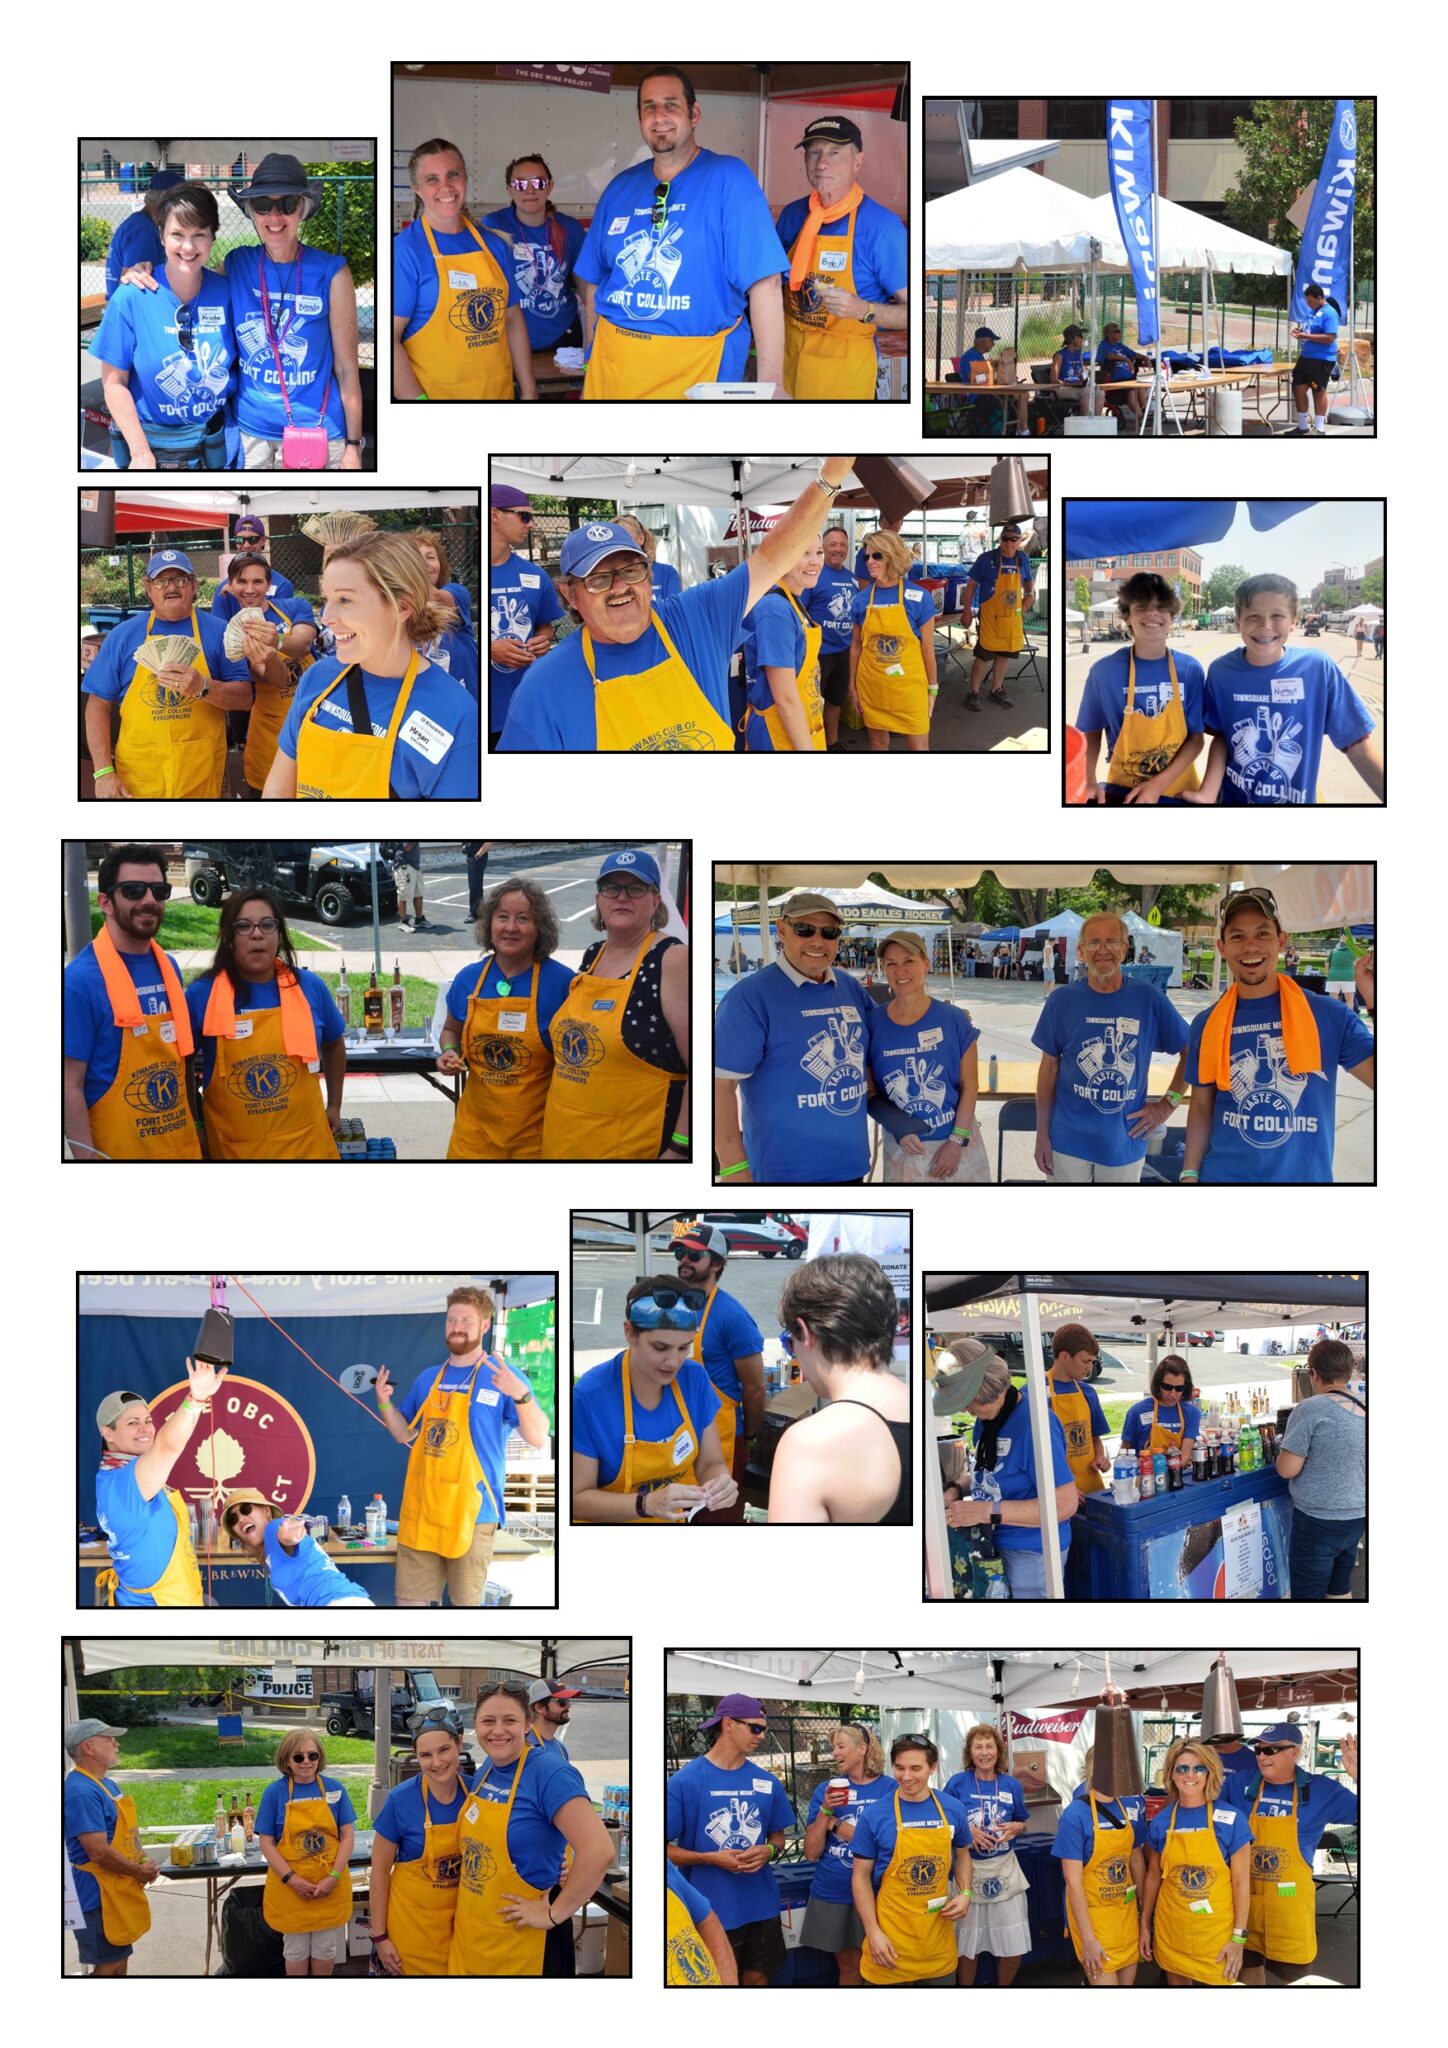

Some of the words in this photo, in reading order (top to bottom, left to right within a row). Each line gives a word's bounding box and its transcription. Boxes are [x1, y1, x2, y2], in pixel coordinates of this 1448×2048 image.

[530, 71, 544, 79] OBC
[545, 74, 562, 82] WINE
[563, 77, 593, 88] PROJECT
[588, 68, 610, 77] Glasses
[652, 276, 662, 288] OF
[456, 288, 481, 300] KIWANIS
[481, 287, 496, 295] CLUB
[636, 292, 691, 310] COLLINS
[475, 302, 487, 325] K
[466, 332, 481, 342] FORT
[615, 327, 652, 341] EYEOPENERS
[467, 337, 499, 349] EYEOPENERS
[823, 620, 841, 629] FORT
[1233, 694, 1270, 704] TOWNSQUARE
[151, 708, 167, 716] FORT
[167, 706, 193, 715] COLLINS
[153, 713, 191, 722] EYEOPENERS
[663, 723, 683, 736] CLUB
[684, 720, 697, 730] OF
[1270, 767, 1283, 781] OF
[1226, 766, 1254, 790] FORT
[1255, 780, 1307, 804] COLLINS
[861, 910, 902, 919] EAGLES
[904, 911, 945, 920] HOCKEY
[569, 1034, 581, 1057] K
[232, 1057, 259, 1069] KIWANIS
[260, 1053, 277, 1061] CLUB
[490, 1047, 507, 1063] K
[130, 1063, 159, 1079] KIWANIS
[160, 1060, 177, 1068] CLUB
[254, 1070, 272, 1093] K
[827, 1067, 850, 1088] TASTE
[849, 1069, 861, 1080] OF
[1093, 1072, 1115, 1086] TASTE
[1114, 1075, 1125, 1086] OF
[156, 1078, 169, 1103] K
[1073, 1083, 1099, 1100] FORT
[1102, 1088, 1137, 1102] COLLINS
[245, 1102, 261, 1110] FORT
[262, 1096, 289, 1107] COLLINS
[797, 1090, 837, 1109] FORT
[1244, 1093, 1270, 1111] TASTE
[1273, 1098, 1287, 1112] OF
[247, 1104, 289, 1115] EYEOPENERS
[923, 1105, 935, 1114] OF
[136, 1116, 161, 1127] FORT
[139, 1120, 187, 1138] EYEOPENERS
[1223, 1111, 1250, 1130] FORT
[1253, 1116, 1318, 1133] COLLINS
[227, 1396, 274, 1429] OBC
[1156, 1474, 1164, 1485] G
[211, 1568, 266, 1581] BREWIN
[262, 1682, 313, 1695] POLICE
[1001, 1713, 1082, 1735] Budweiser
[918, 1864, 929, 1881] K
[1188, 1871, 1200, 1886] K
